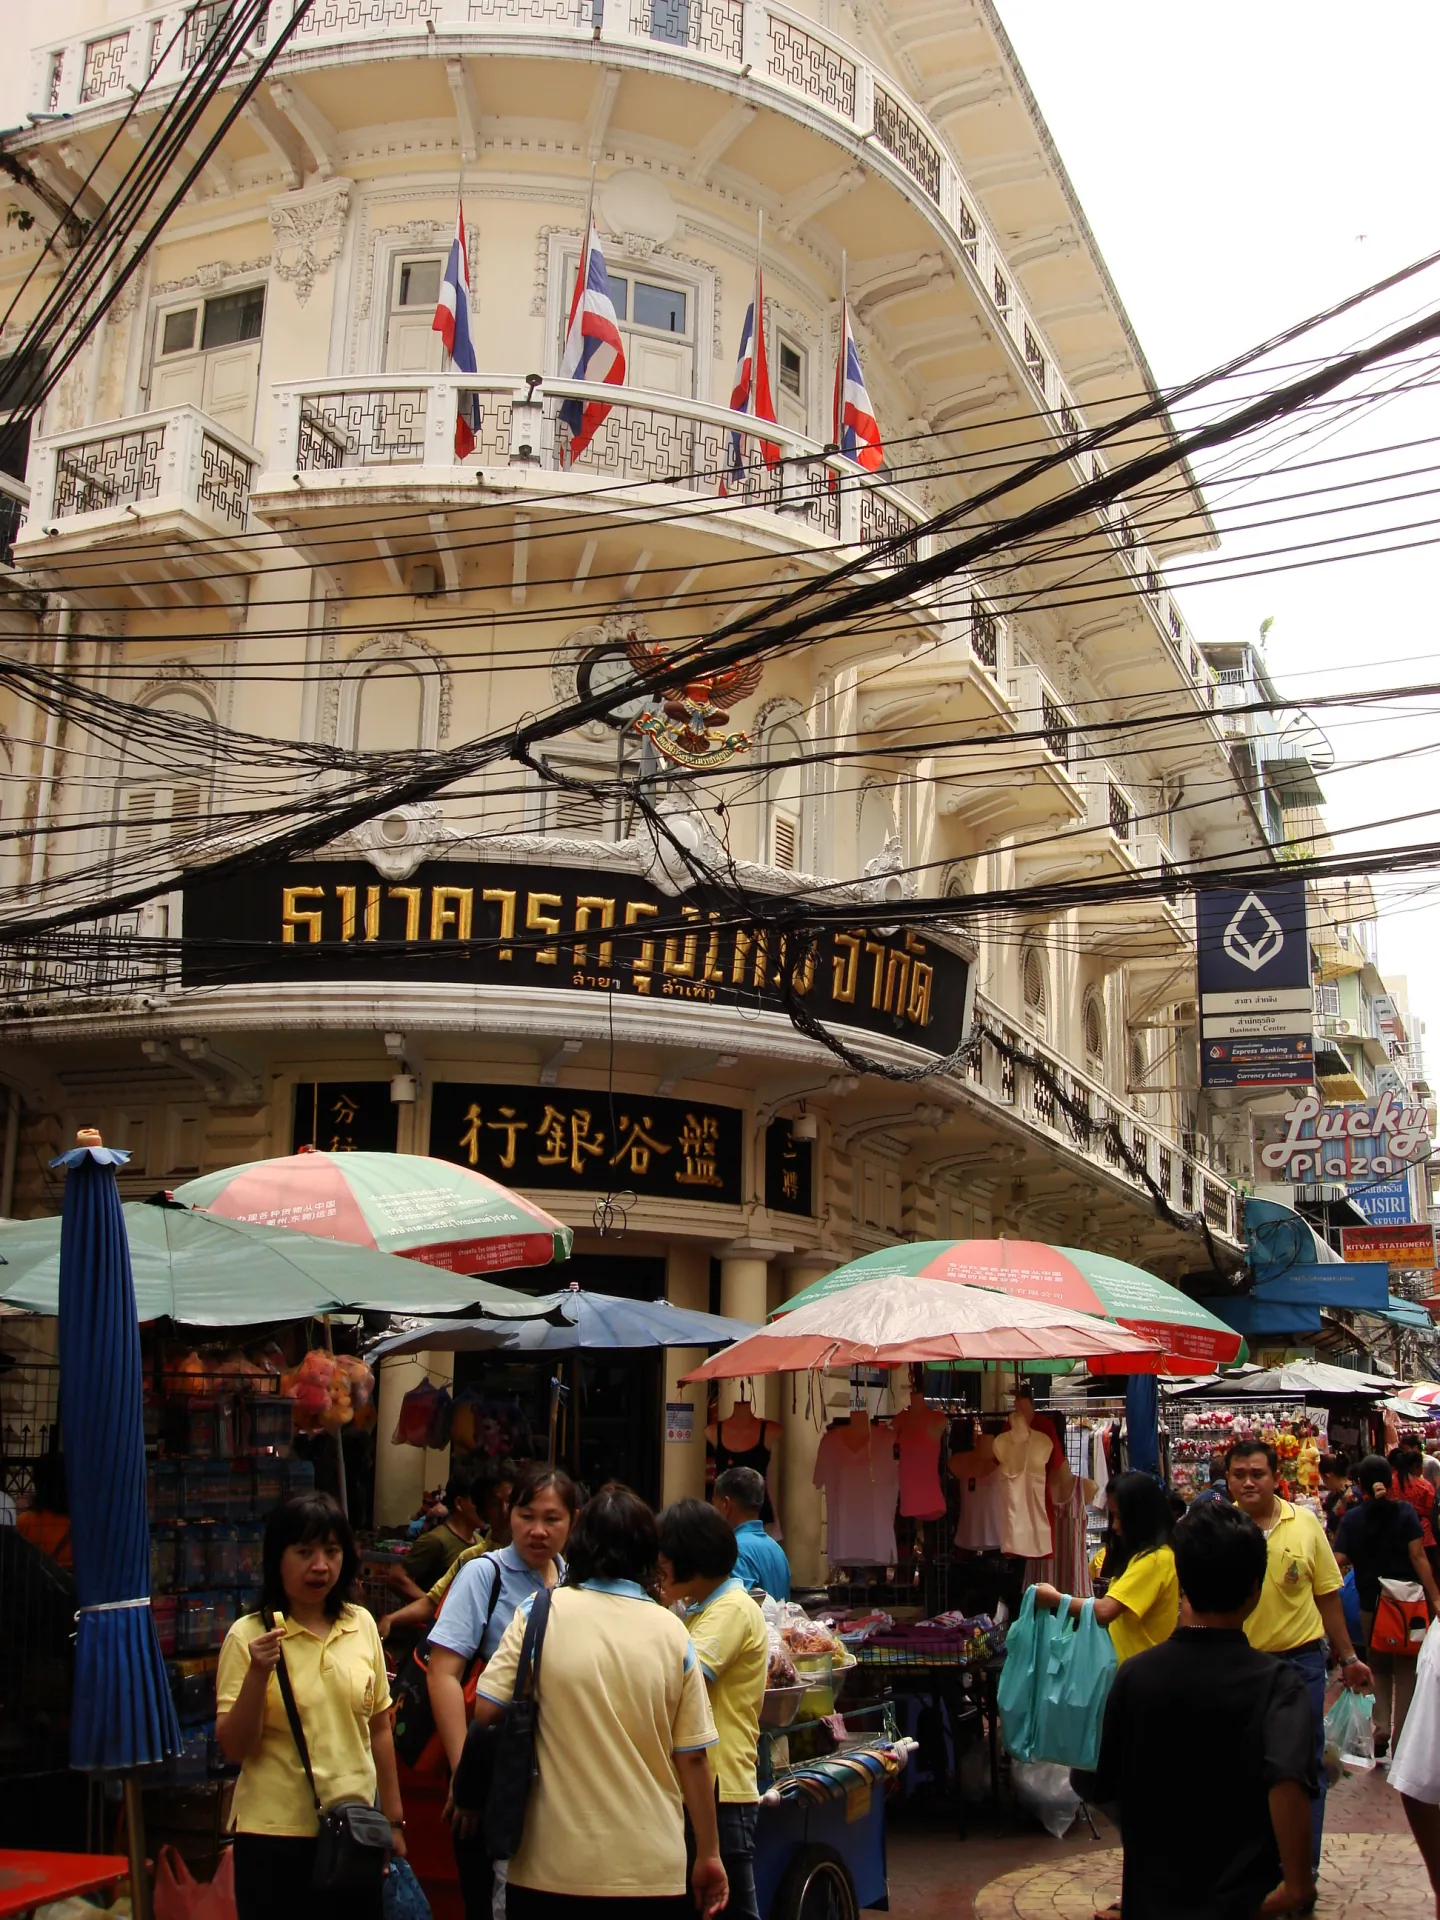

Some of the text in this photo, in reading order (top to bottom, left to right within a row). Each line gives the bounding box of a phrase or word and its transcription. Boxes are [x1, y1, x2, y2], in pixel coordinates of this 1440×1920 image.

[1229, 1026, 1260, 1034] Business
[1231, 1048, 1258, 1056] Express
[1260, 1046, 1288, 1054] Banking
[1237, 1071, 1298, 1080] Currency Exchange
[1261, 1091, 1428, 1168] Lucky
[232, 1199, 336, 1222] 办理各种货物从中国
[1346, 1241, 1432, 1251] KITVAT STATIONERY
